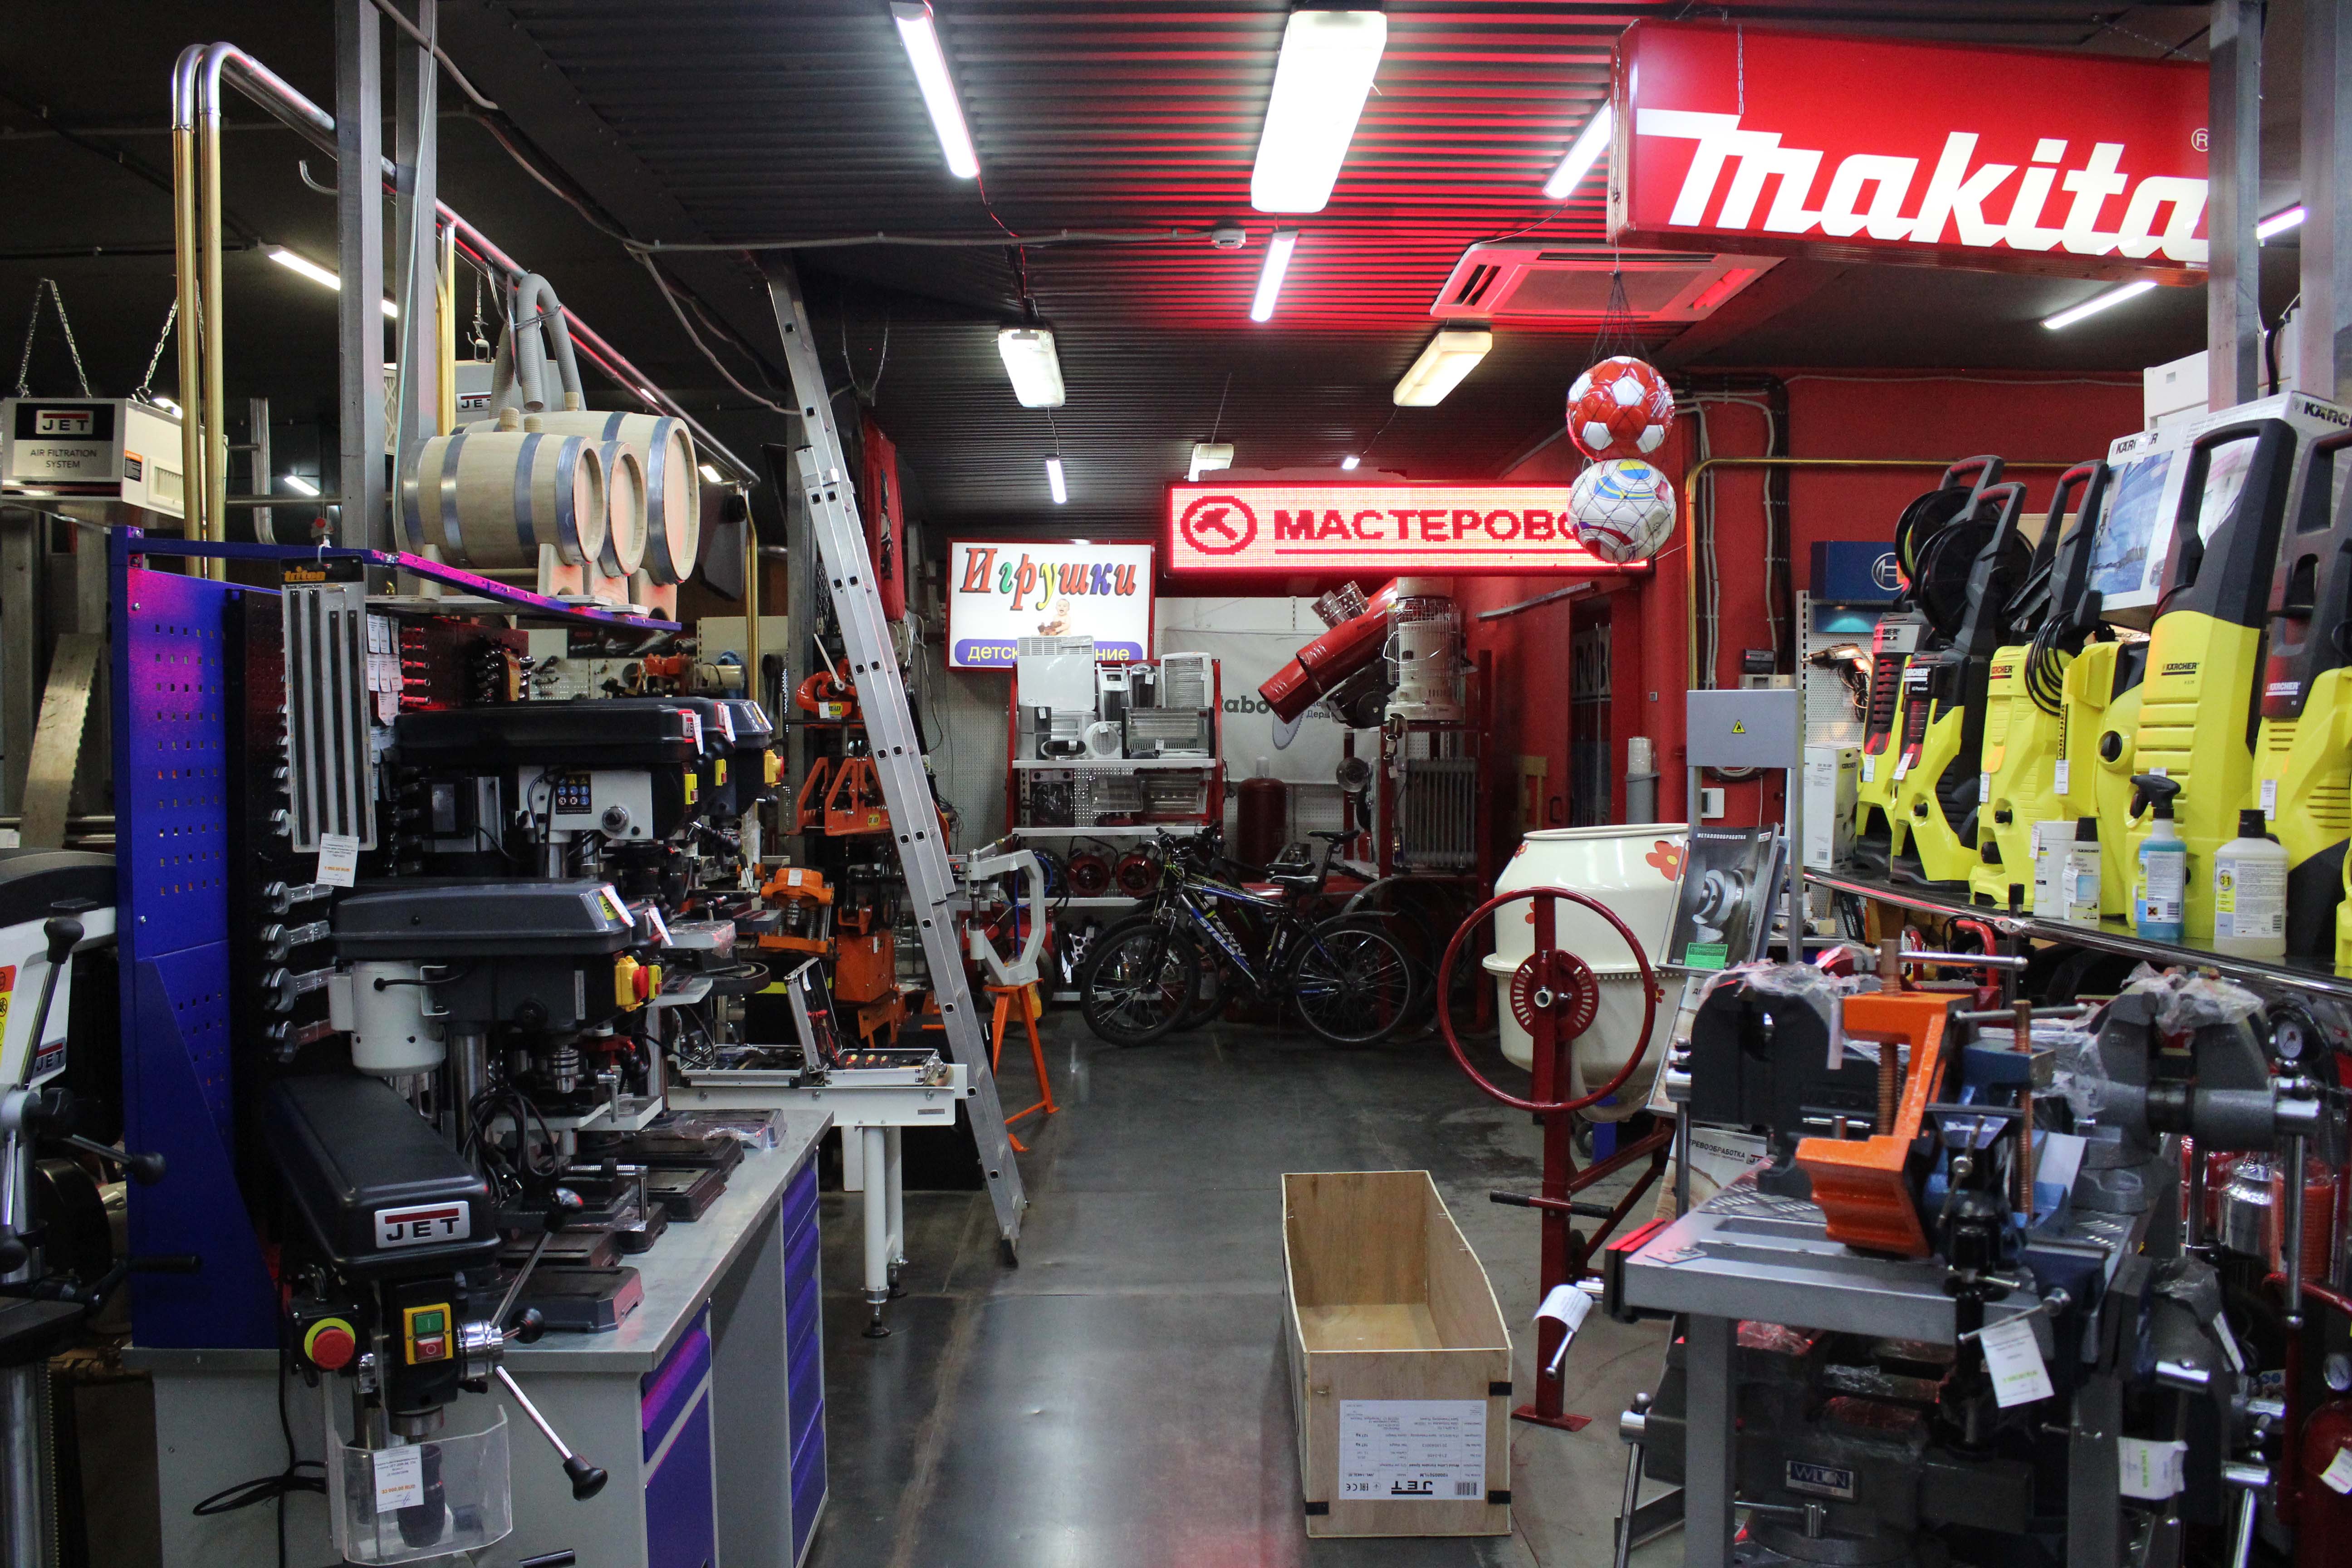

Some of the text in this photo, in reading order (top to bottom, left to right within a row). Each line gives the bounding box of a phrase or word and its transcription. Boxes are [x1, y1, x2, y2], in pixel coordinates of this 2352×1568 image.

[43, 420, 88, 431] JET
[284, 566, 326, 582] triton
[959, 547, 1137, 611] Игрушки
[967, 646, 1018, 662] детск
[1197, 917, 1235, 956] STELS
[36, 1050, 63, 1072] JET
[386, 1217, 460, 1241] JET
[1391, 1481, 1433, 1490] JET
